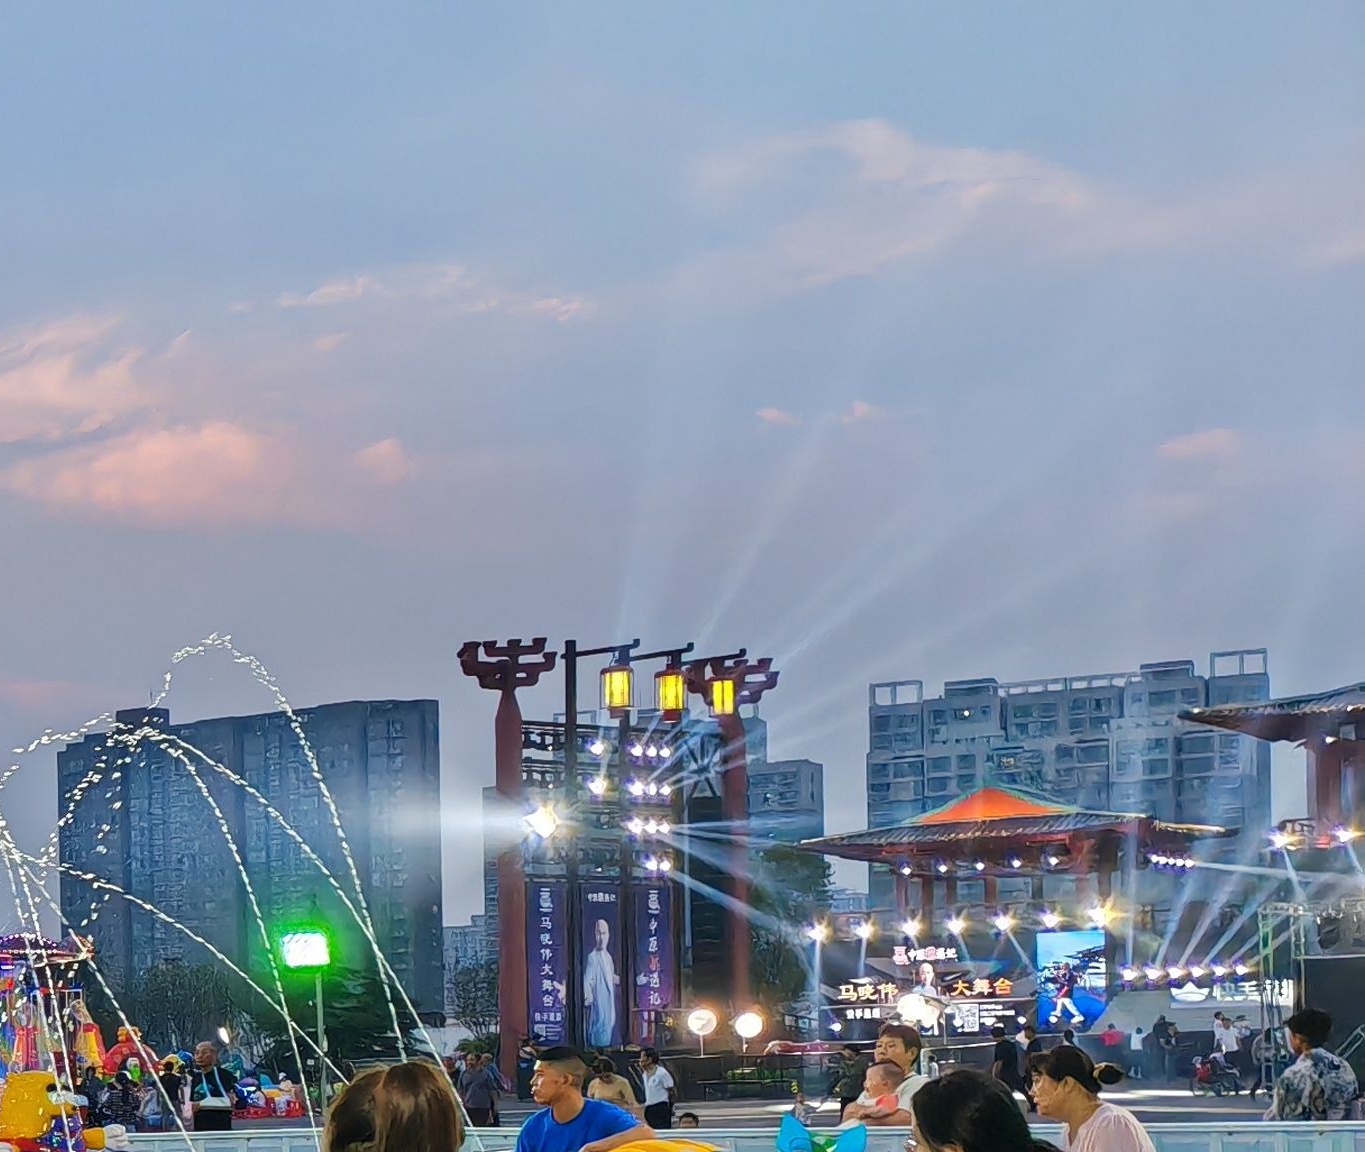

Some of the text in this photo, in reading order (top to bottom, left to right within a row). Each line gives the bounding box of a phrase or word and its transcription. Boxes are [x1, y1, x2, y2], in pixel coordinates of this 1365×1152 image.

[838, 978, 1013, 1001] 马晓伟 大舞台
